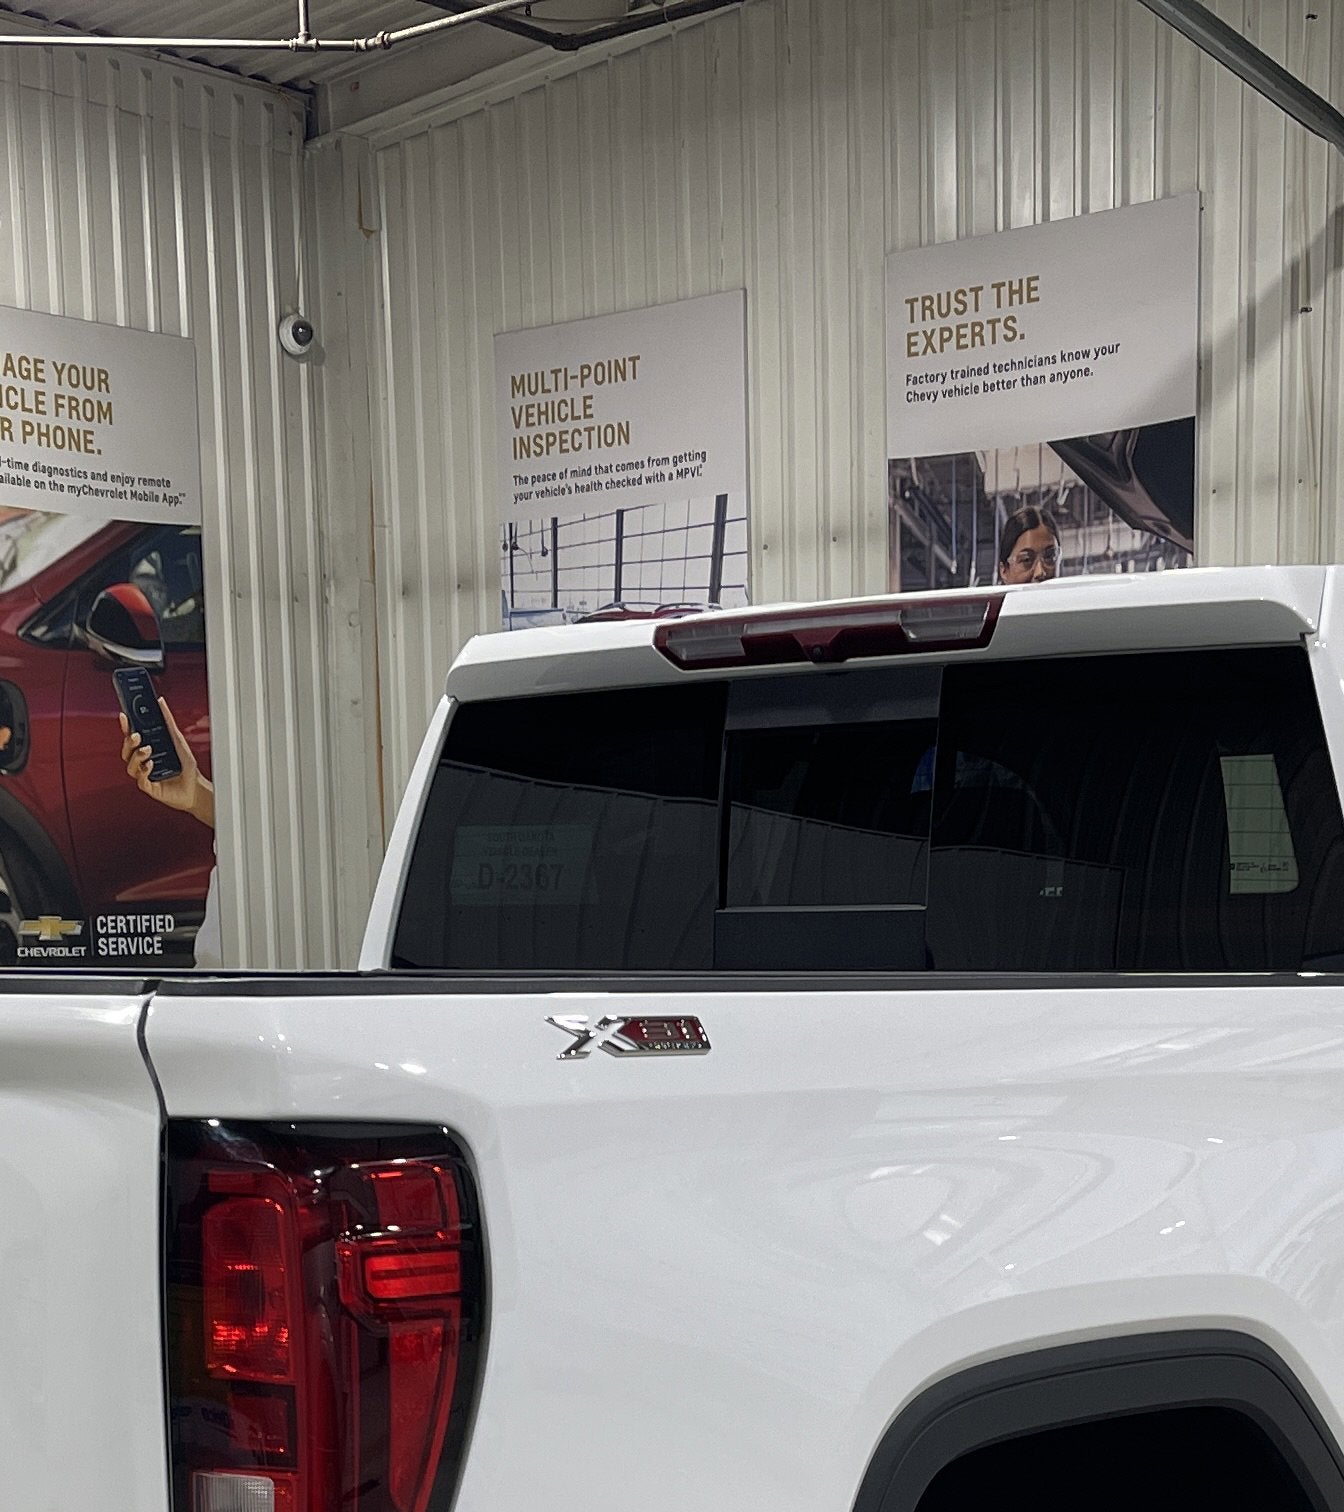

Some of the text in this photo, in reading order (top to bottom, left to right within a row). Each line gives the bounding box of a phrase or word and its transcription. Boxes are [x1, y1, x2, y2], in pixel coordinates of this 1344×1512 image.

[905, 275, 1040, 324] TRUST THE
[906, 315, 1025, 358] EXPERTS.
[52, 360, 111, 394] YOUR
[510, 355, 640, 399] MULTI-POINT
[906, 343, 1120, 386] Factory trained technicians know your
[906, 366, 1094, 403] Chevy vehicle better than anyone.
[53, 392, 113, 426] FROM
[510, 395, 594, 430] VEHICLE
[21, 419, 102, 456] PHONE.
[512, 420, 630, 460] INSPECTION
[32, 461, 88, 479] diagnostics
[90, 470, 108, 483] and
[110, 472, 136, 488] enjoy
[137, 477, 172, 489] remote
[513, 449, 707, 488] The peace of mind that comes from getting
[34, 480, 47, 490] on
[48, 479, 65, 493] the
[67, 484, 128, 501] myChevrolet
[130, 489, 160, 503] Mobile
[513, 489, 534, 505] your
[574, 479, 603, 494] health
[605, 473, 643, 490] checked
[644, 471, 666, 484] with
[96, 914, 175, 934] CERTIFIED
[17, 946, 87, 958] CHEVROLET
[97, 936, 163, 956] SERVICE
